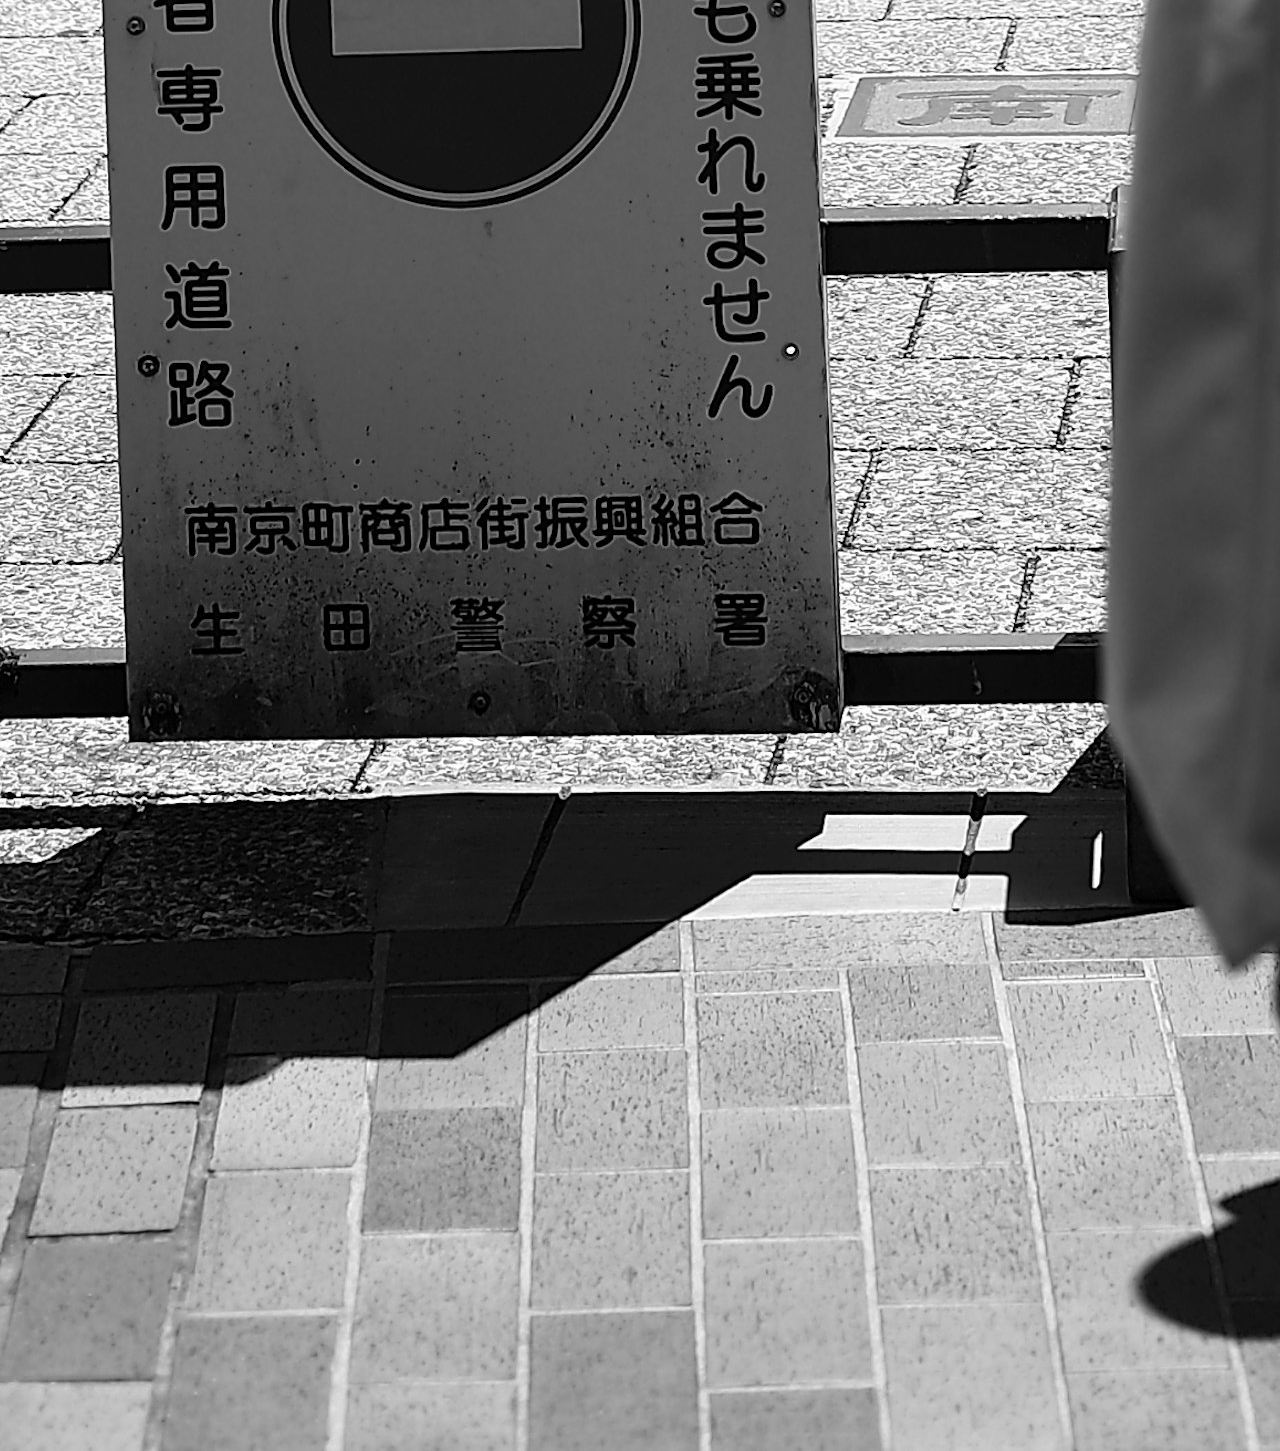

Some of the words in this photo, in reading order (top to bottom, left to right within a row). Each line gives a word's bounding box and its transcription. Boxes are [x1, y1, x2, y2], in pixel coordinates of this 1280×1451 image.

[184, 490, 765, 559] 南京町商店街振興組合
[189, 591, 769, 658] 生田警察署
